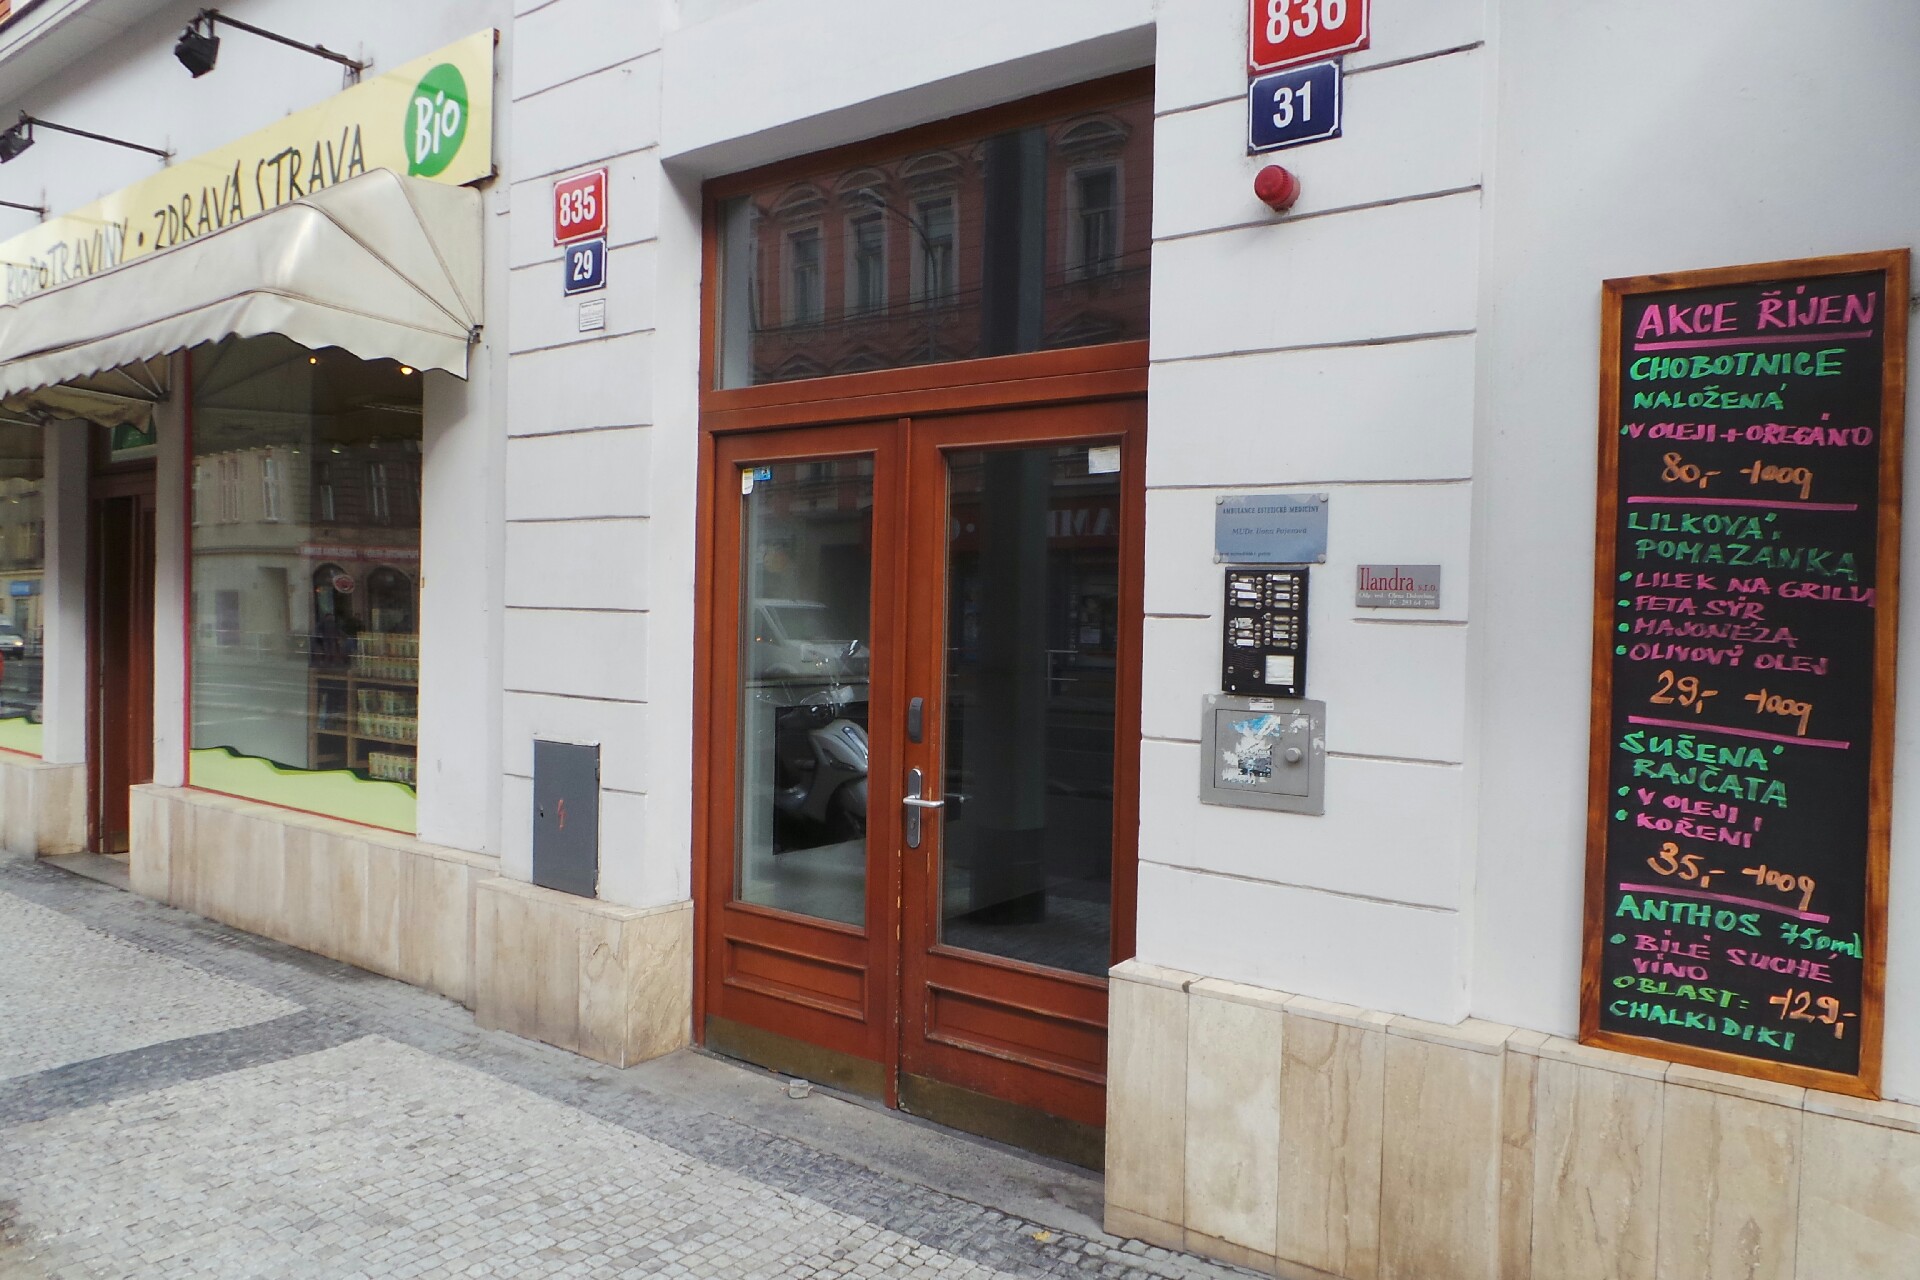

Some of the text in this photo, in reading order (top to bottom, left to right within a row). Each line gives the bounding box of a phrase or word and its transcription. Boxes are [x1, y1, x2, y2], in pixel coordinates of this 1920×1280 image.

[1273, 80, 1311, 129] 31
[256, 124, 365, 211] STRAVA
[559, 185, 595, 226] 835
[573, 250, 593, 281] 29
[1635, 301, 1738, 339] AKCE
[1629, 348, 1846, 381] CHOBOTNICE
[1633, 383, 1787, 410] NALOŽENÁ
[1628, 422, 1645, 438] V
[1418, 584, 1438, 592] s.r.o.
[1634, 572, 1718, 591] LILEK
[1727, 577, 1772, 595] NA
[1635, 595, 1765, 620] FETA SÝR
[1754, 654, 1829, 675] OLEJ
[1633, 758, 1788, 808] RAJČATA
[1637, 787, 1739, 823] V OLEJI
[1615, 894, 1761, 937] ANTHOS
[1609, 1000, 1795, 1051] CHALKIDIKI
